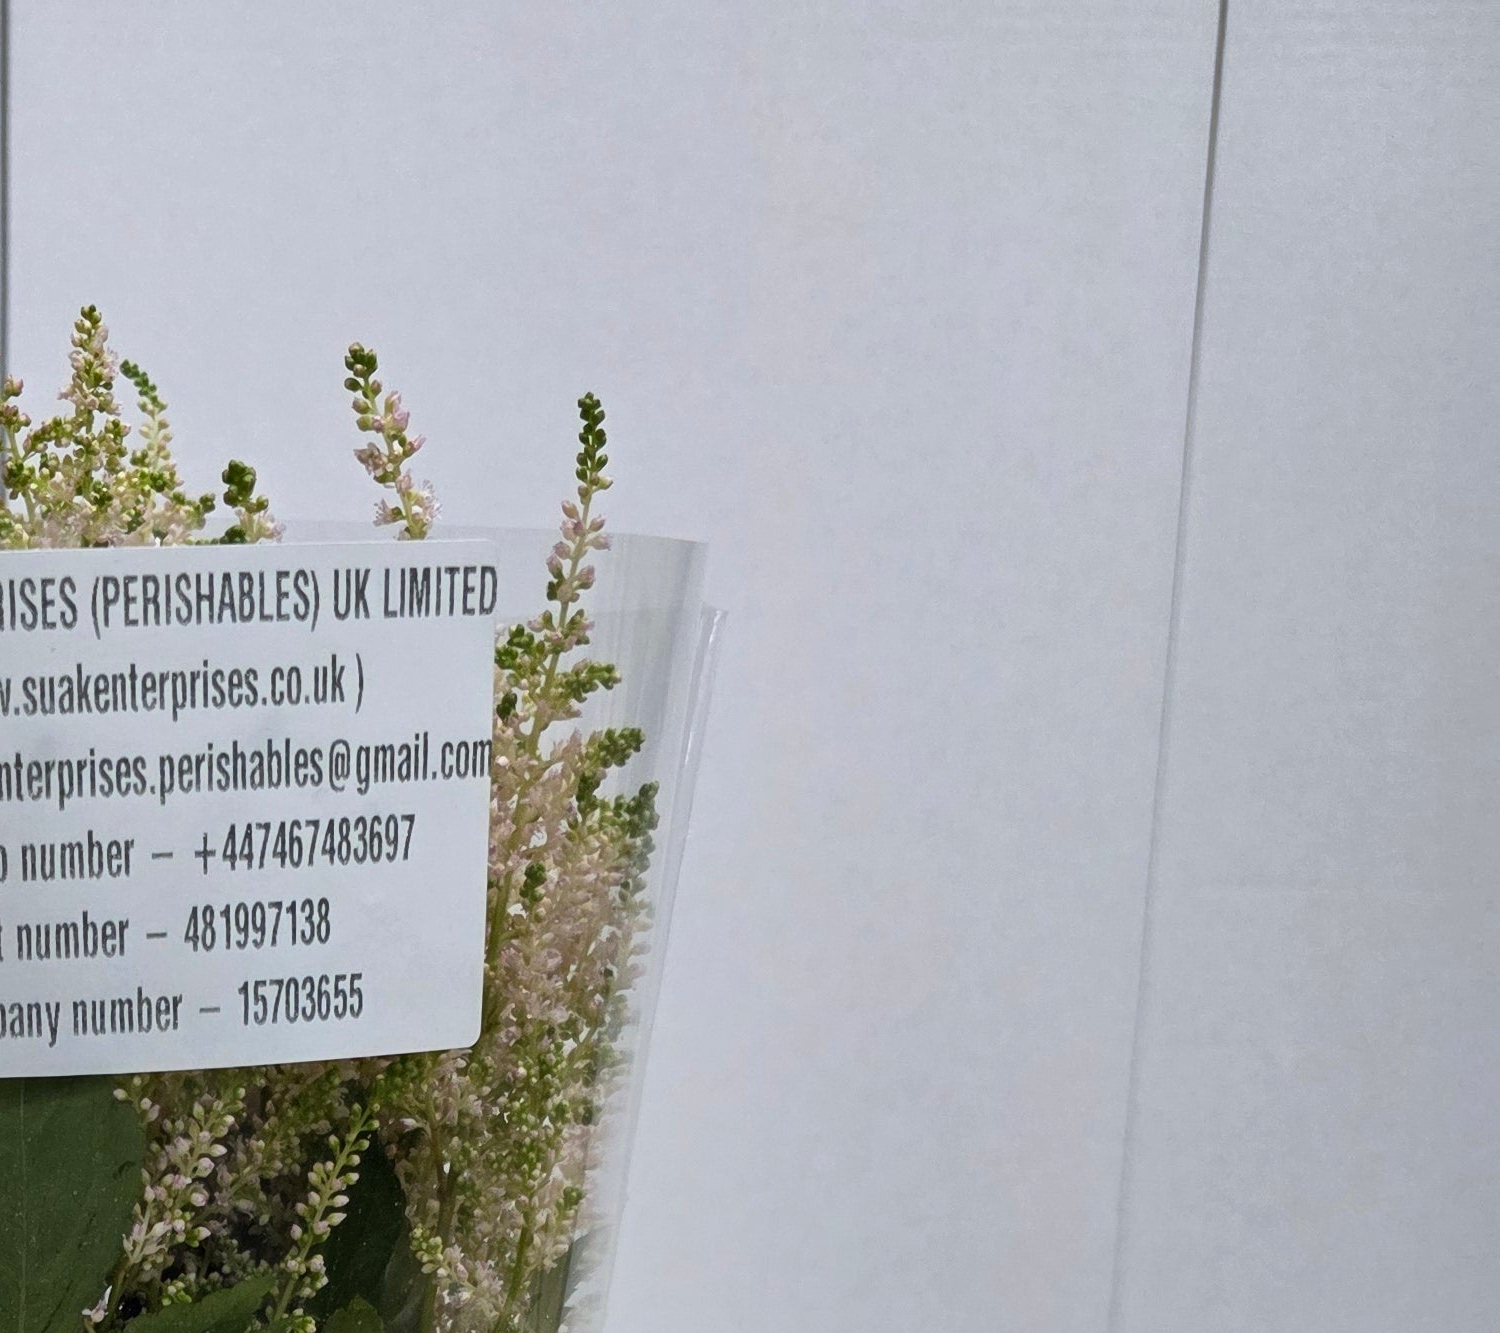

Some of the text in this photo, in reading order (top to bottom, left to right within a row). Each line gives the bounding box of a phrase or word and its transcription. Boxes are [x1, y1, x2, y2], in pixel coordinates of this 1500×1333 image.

[91, 569, 320, 639] (PERISHABLES)
[333, 568, 371, 621] UK
[383, 565, 498, 618] LIMITED
[21, 829, 135, 882] number
[194, 813, 416, 875] +447467483697
[16, 910, 129, 960] number
[184, 897, 331, 952] 481997138
[72, 987, 183, 1036] number
[238, 972, 363, 1026] 15703655
